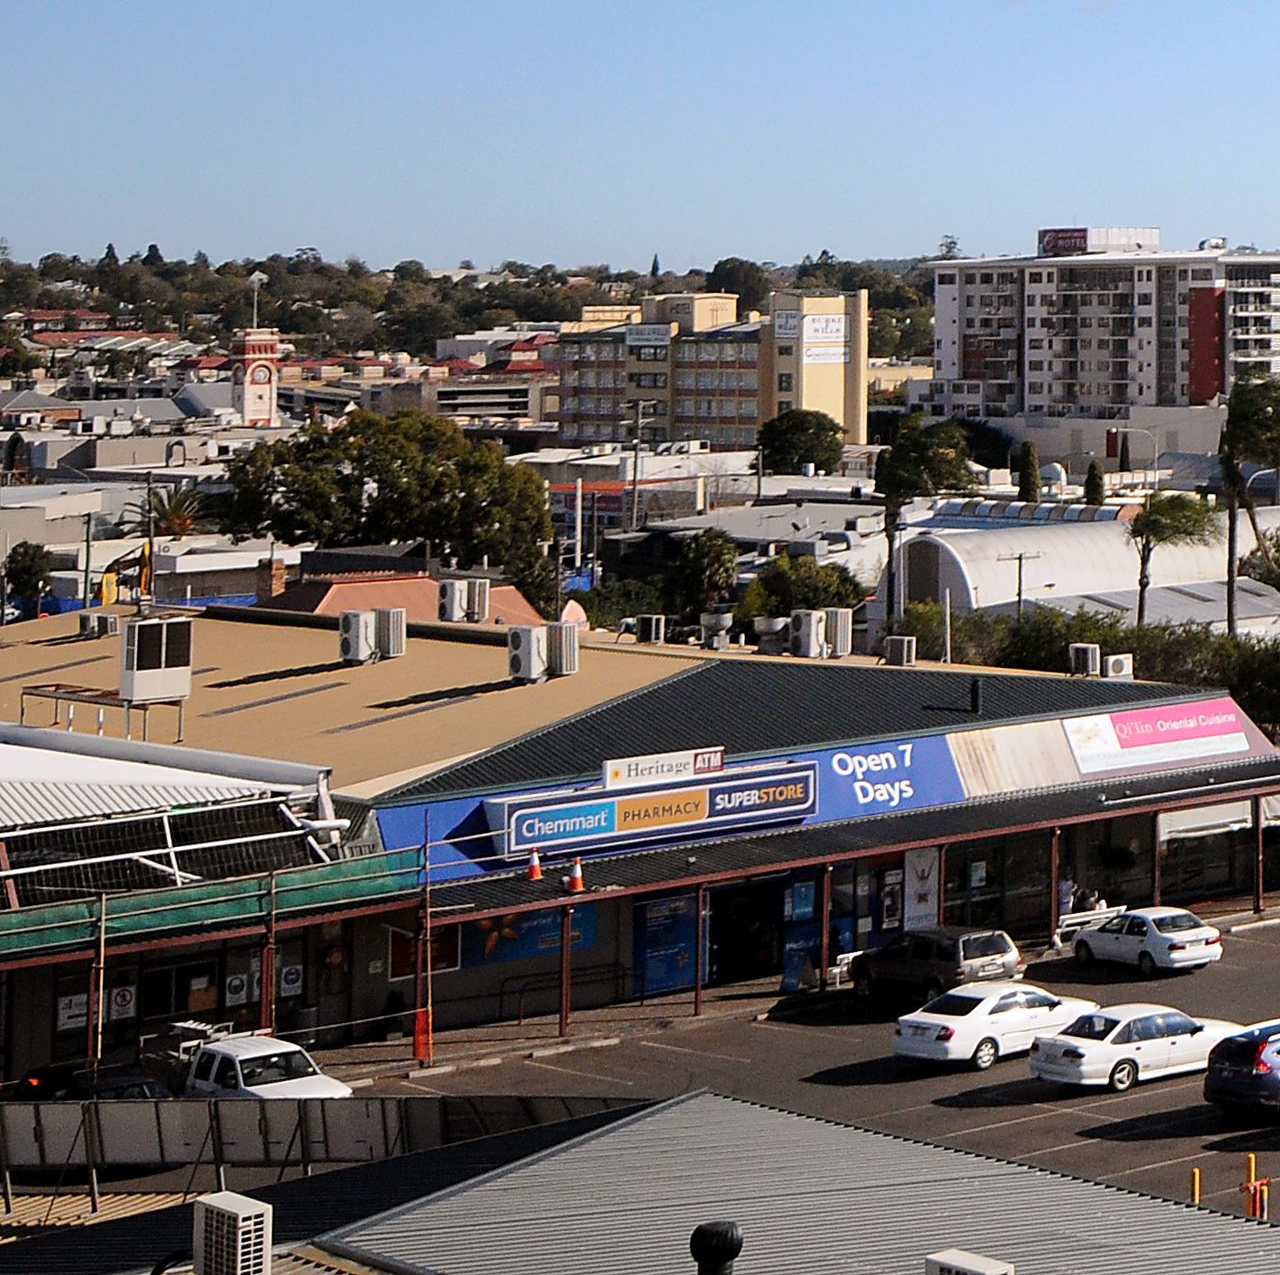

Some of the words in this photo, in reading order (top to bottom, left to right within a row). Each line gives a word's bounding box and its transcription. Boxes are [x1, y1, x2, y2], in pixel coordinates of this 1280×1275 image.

[1156, 718, 1198, 733] Oriental
[626, 760, 691, 778] Heritage
[695, 751, 722, 771] ATM
[832, 752, 897, 780] Open
[897, 743, 914, 767] 7
[853, 780, 914, 807] Days
[521, 809, 608, 839] Chemmart
[622, 801, 701, 823] PHARMACY
[714, 783, 806, 811] SUPERSTORE
